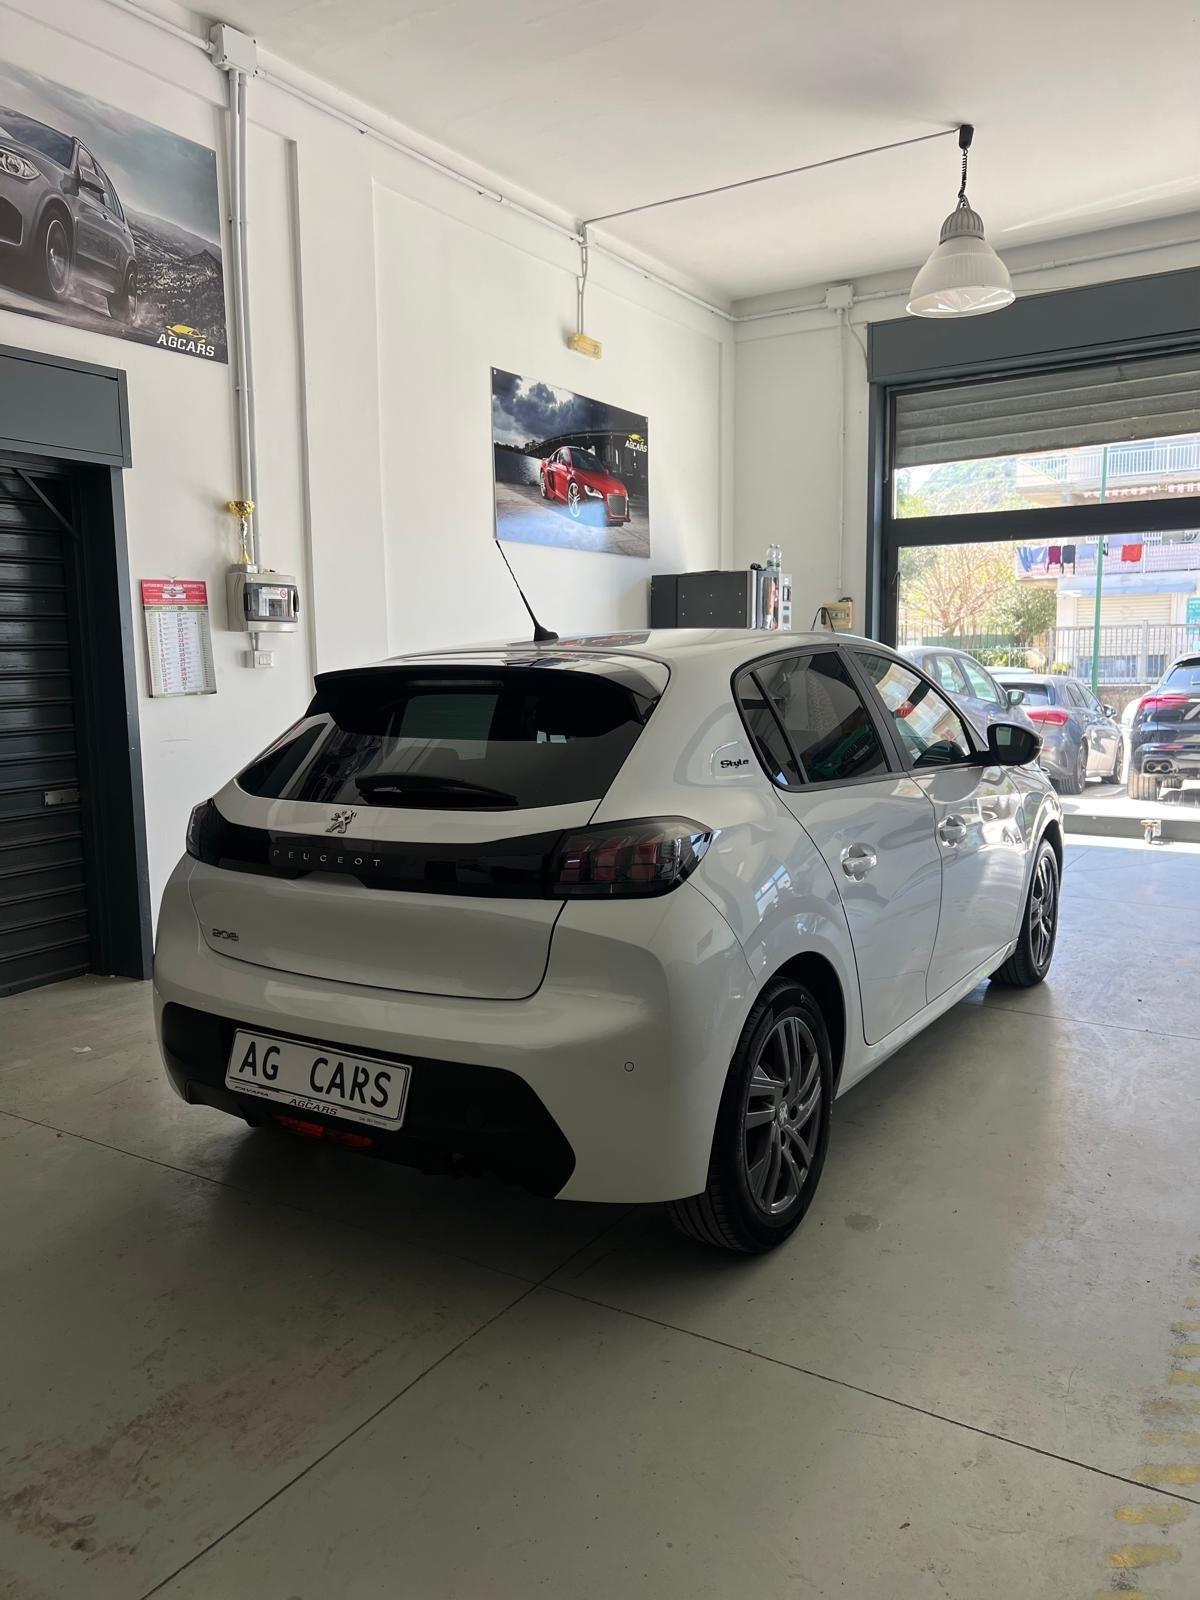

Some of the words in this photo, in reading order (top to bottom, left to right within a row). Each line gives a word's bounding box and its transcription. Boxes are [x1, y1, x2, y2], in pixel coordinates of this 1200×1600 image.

[156, 333, 215, 356] AGCARS
[720, 759, 749, 768] Style
[273, 850, 381, 866] PEUGEOT
[238, 1041, 281, 1081] AG
[309, 1057, 392, 1108] CARS
[289, 1099, 338, 1115] AGCARS
